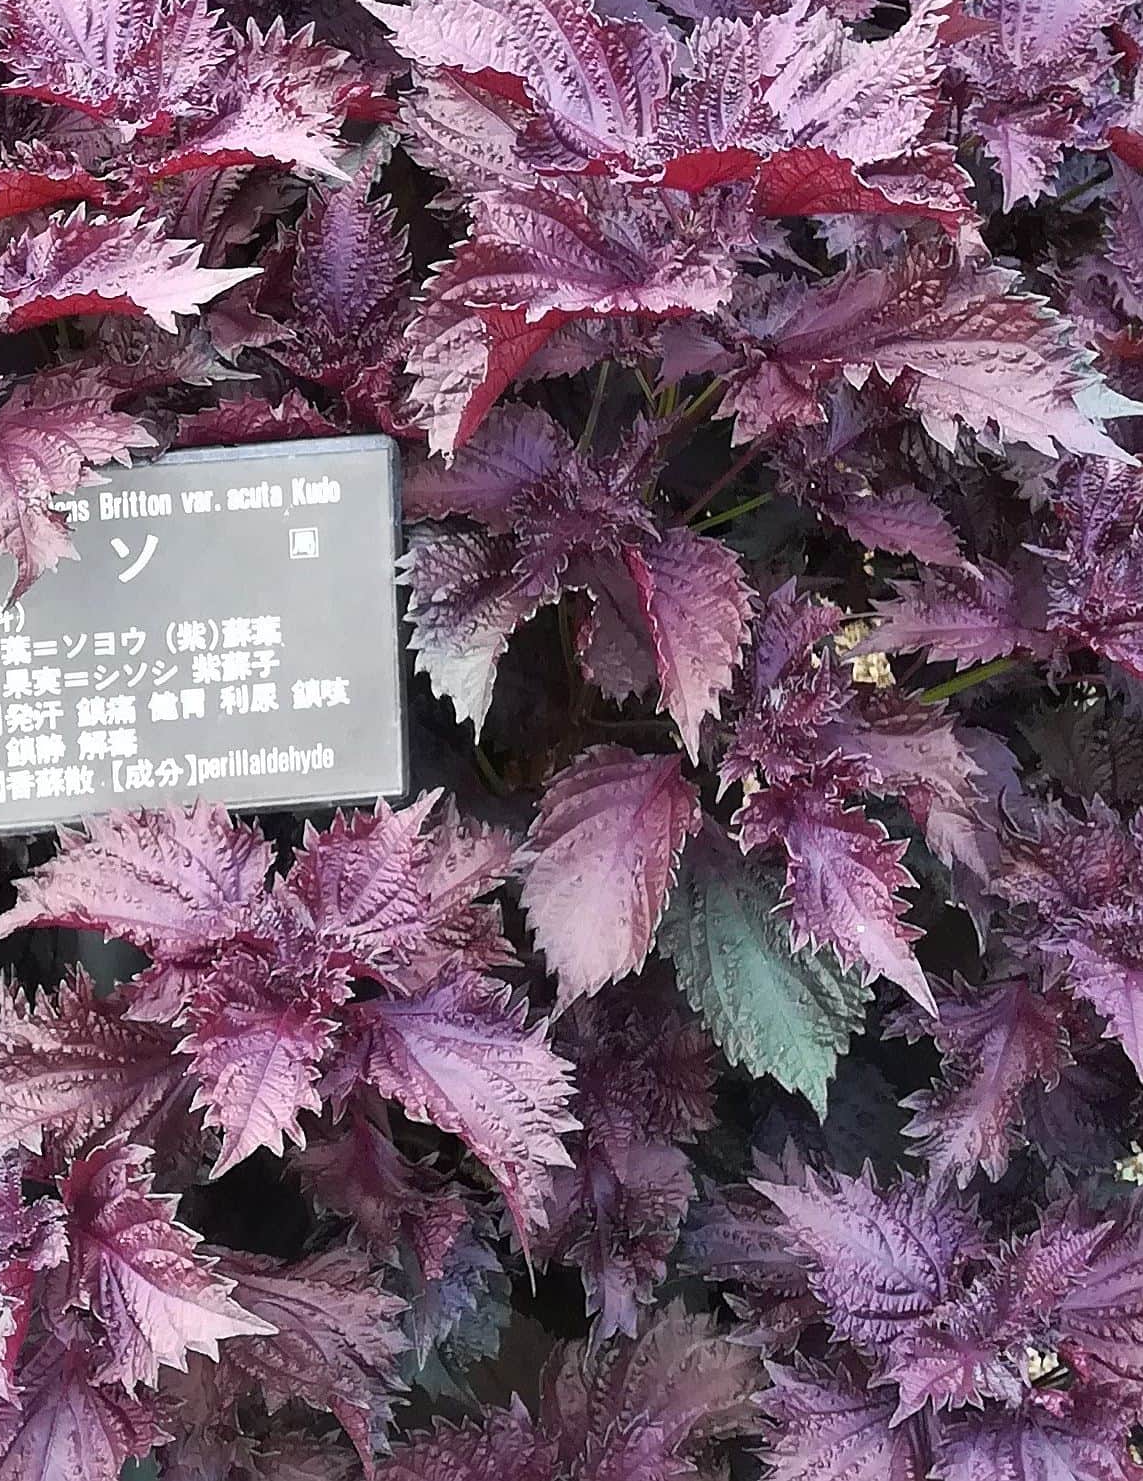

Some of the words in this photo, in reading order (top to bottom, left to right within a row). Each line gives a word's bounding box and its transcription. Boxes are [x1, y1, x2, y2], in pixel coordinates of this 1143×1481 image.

[99, 490, 172, 520] Britton
[180, 489, 222, 514] var.
[227, 481, 283, 511] acuta
[291, 475, 341, 506] Kudo
